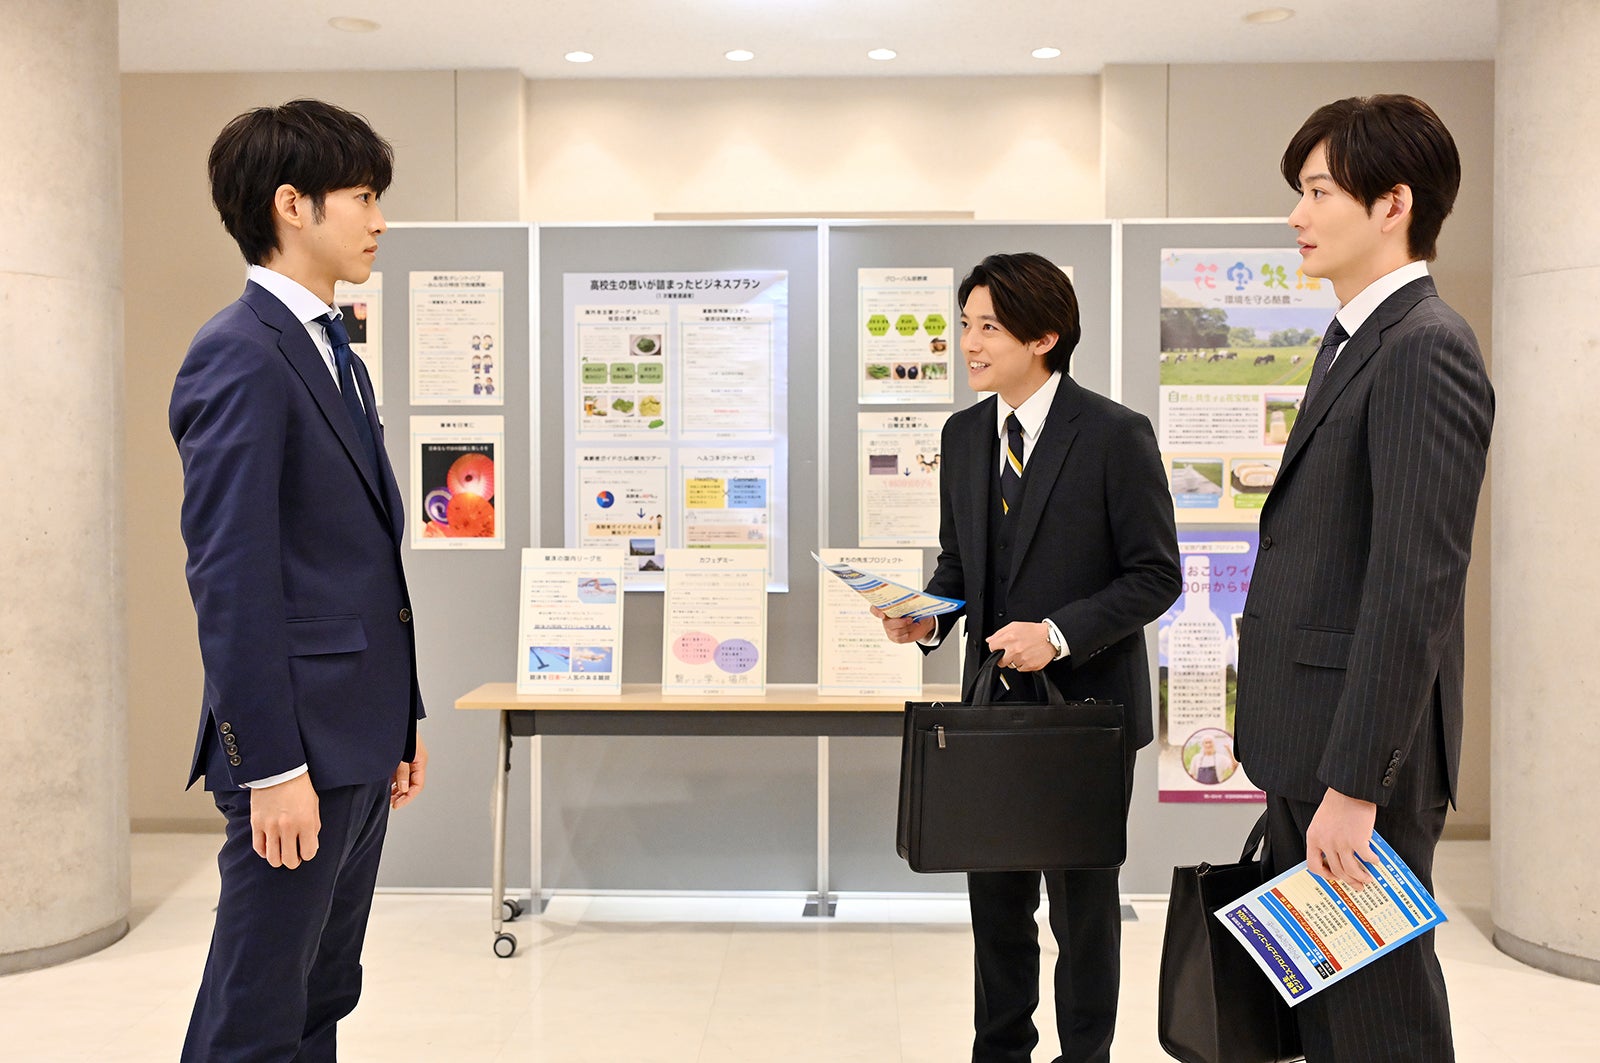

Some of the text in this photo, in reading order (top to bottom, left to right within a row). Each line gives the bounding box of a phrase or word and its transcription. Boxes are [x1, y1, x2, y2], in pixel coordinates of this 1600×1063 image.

[590, 279, 760, 291] 高校生の想いが詰まったビジネスプラン
[1181, 565, 1250, 577] おこしワイ
[1281, 974, 1300, 995] 高校生
